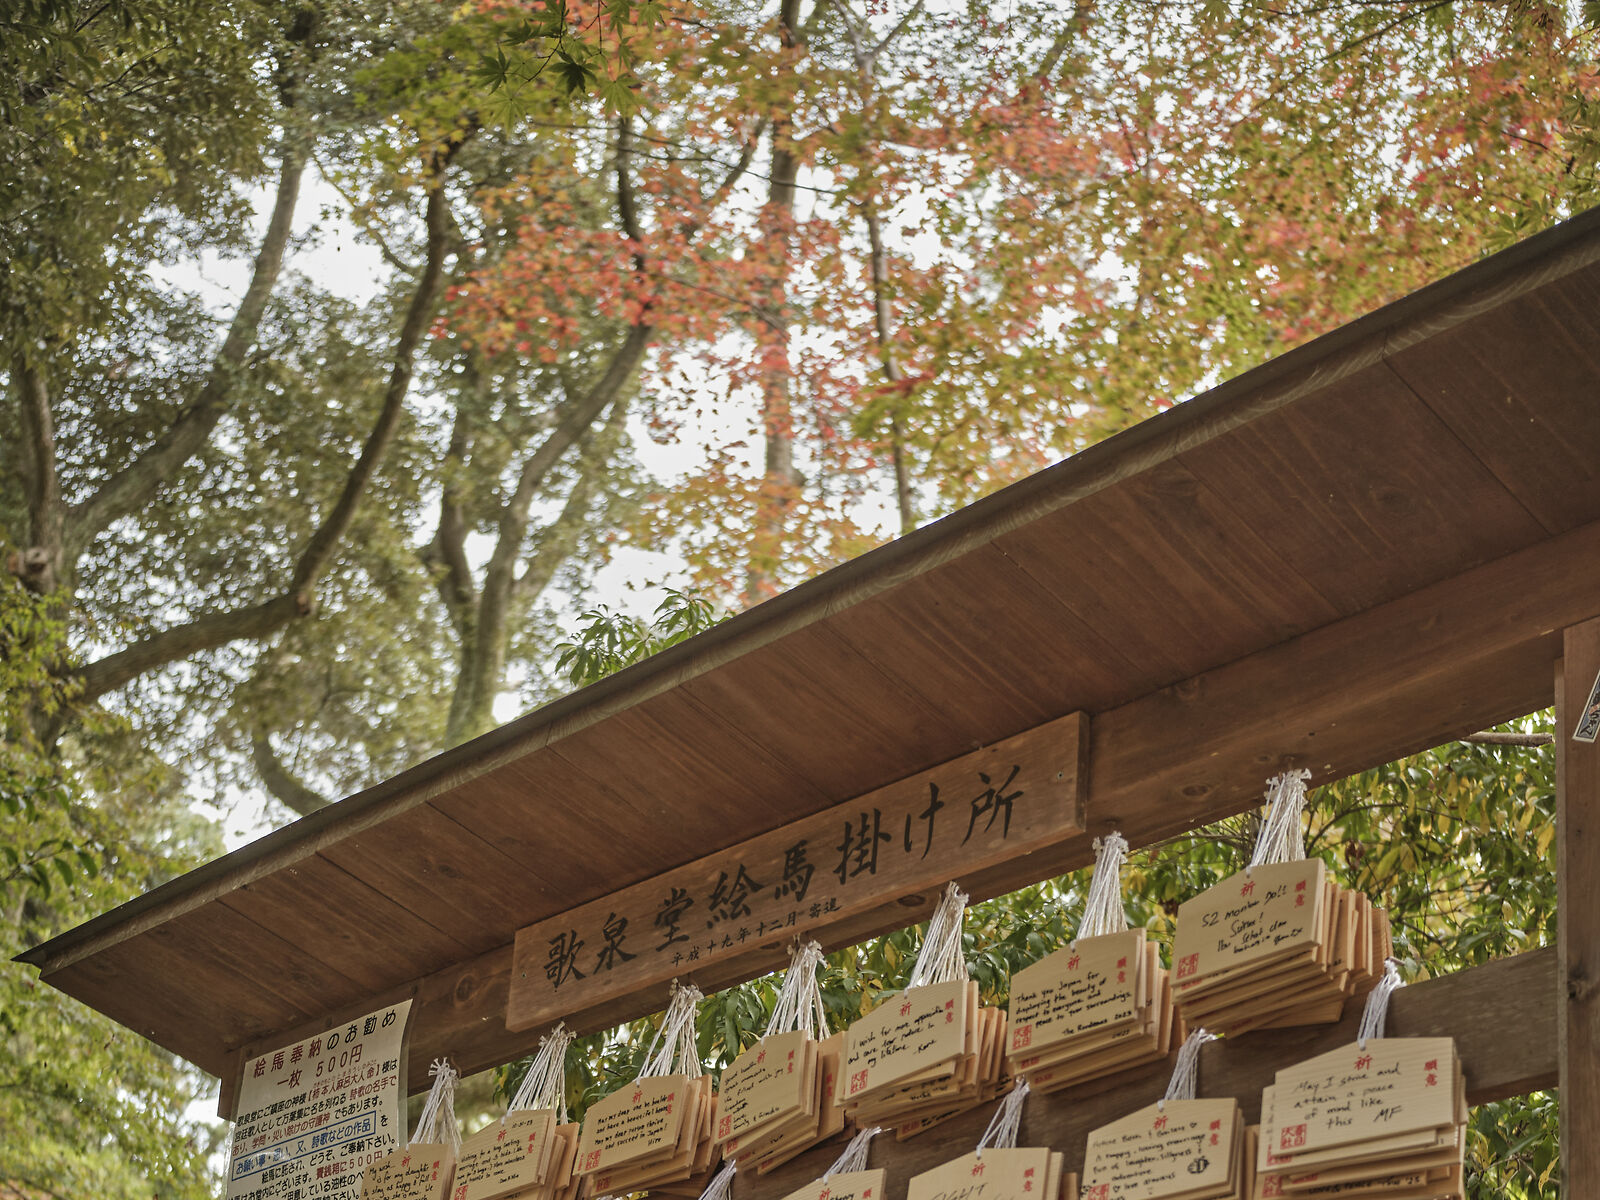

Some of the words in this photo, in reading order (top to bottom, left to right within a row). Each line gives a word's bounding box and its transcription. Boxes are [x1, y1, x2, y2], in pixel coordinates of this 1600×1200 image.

[544, 764, 1024, 992] 歌泉堂絵馬掛け所
[1240, 881, 1255, 896] 祈
[1016, 993, 1036, 1003] Thank
[1042, 988, 1053, 997] you
[1059, 978, 1082, 991] Japan
[1088, 971, 1099, 980] for
[1054, 993, 1065, 1003] the
[1072, 984, 1095, 996] beauty
[1099, 978, 1107, 986] of
[1088, 991, 1100, 999] and
[1114, 1011, 1132, 1020] 2023
[253, 1009, 396, 1078] 絵馬奉納のお勧め
[859, 1032, 875, 1047] wish
[881, 1026, 891, 1037] for
[848, 1054, 859, 1065] and
[1354, 1055, 1372, 1070] 祈
[277, 1069, 302, 1089] 一枚
[1292, 1081, 1320, 1094] May
[1324, 1077, 1334, 1089] I
[1377, 1062, 1401, 1075] and
[1294, 1095, 1337, 1108] attain
[1363, 1083, 1395, 1096] peace
[1360, 1098, 1383, 1108] like
[1153, 1115, 1168, 1129] 祈
[1326, 1118, 1353, 1129] this
[970, 1163, 985, 1176] 祈
